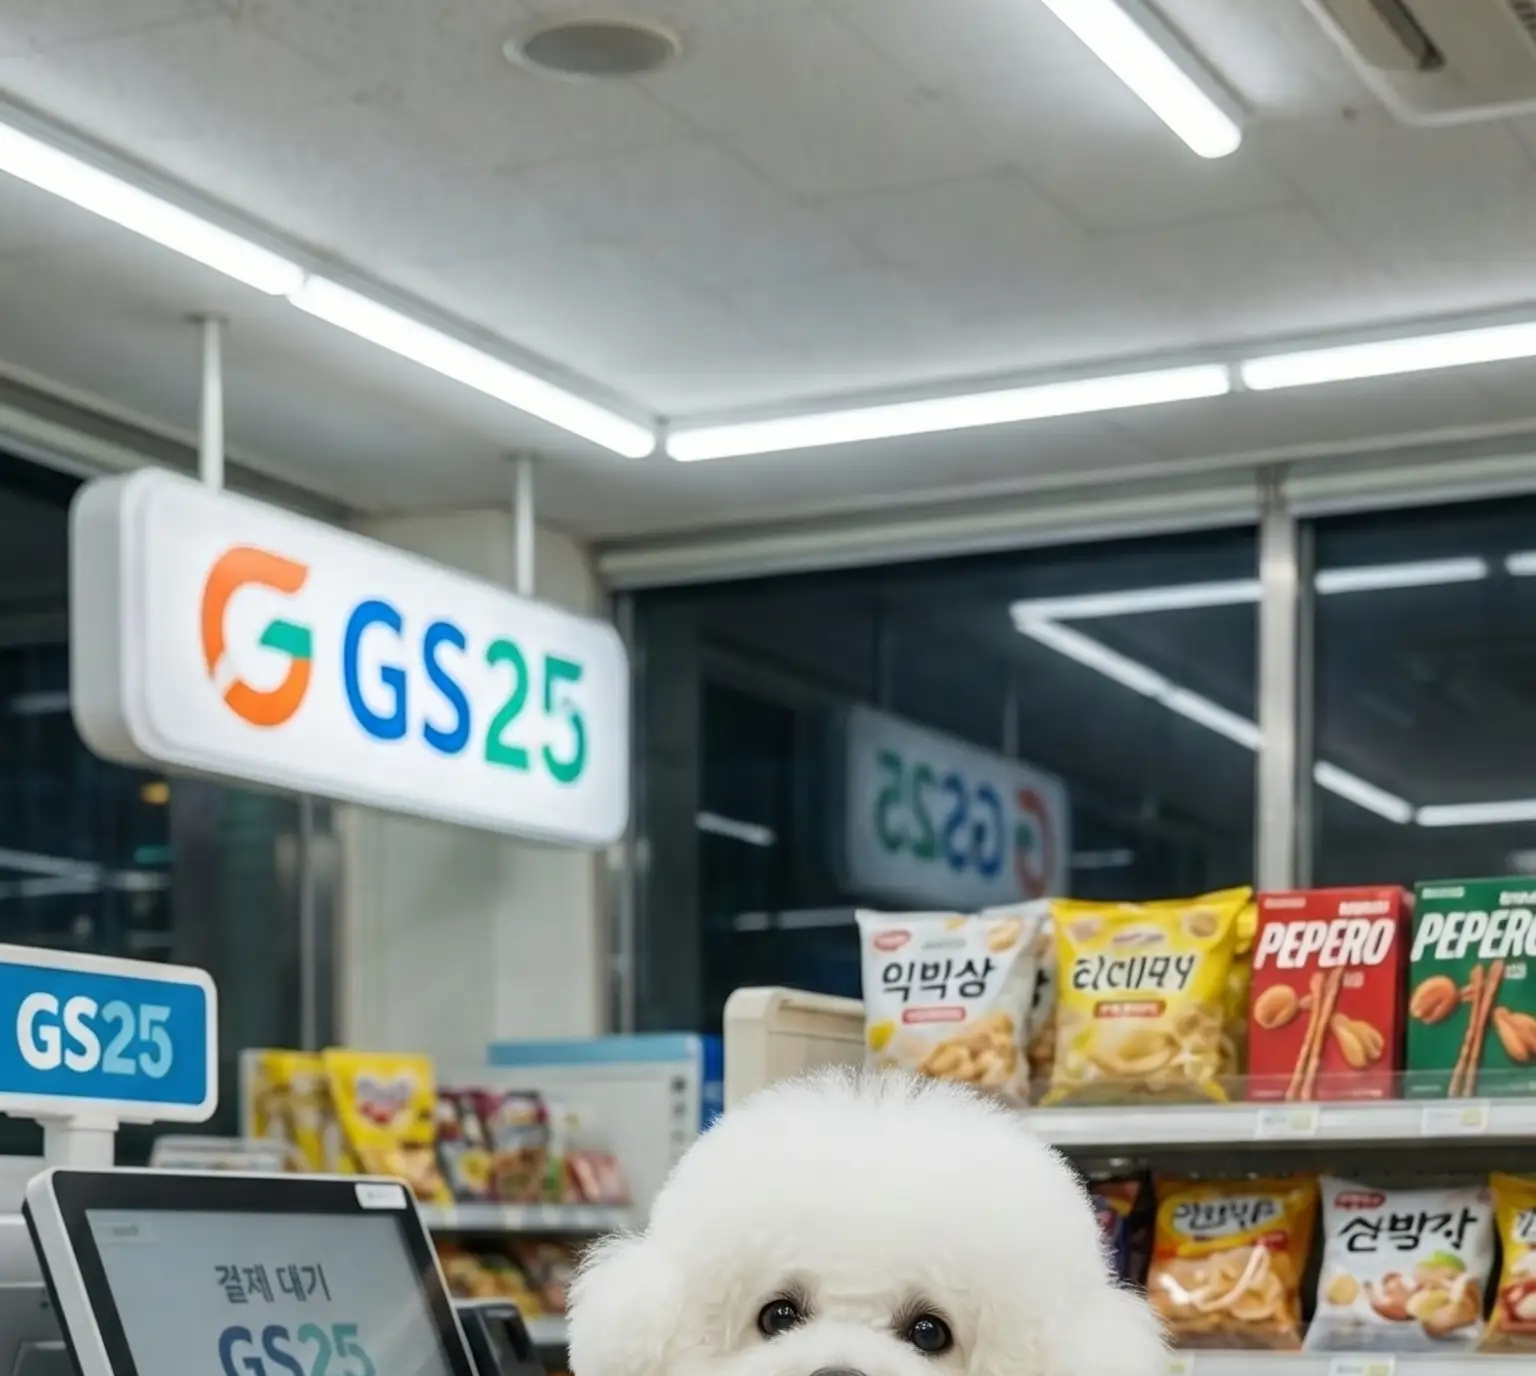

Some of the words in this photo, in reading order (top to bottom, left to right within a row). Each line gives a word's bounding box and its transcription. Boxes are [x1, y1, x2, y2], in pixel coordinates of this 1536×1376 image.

[343, 599, 588, 783] GS25
[1254, 918, 1395, 969] PEPERO
[16, 992, 174, 1079] GS25
[215, 1264, 275, 1304] 결제
[276, 1263, 332, 1302] 대기
